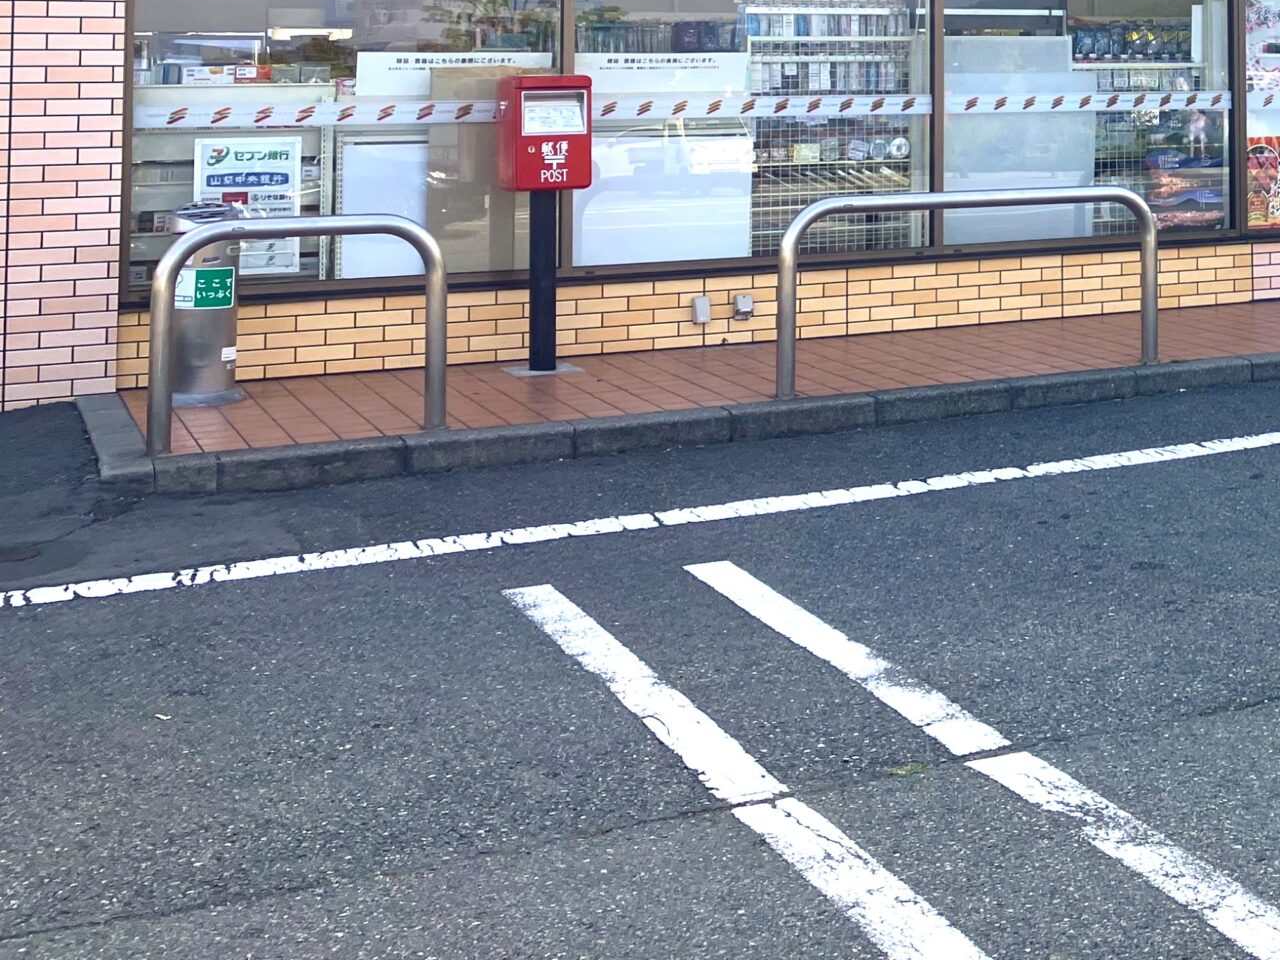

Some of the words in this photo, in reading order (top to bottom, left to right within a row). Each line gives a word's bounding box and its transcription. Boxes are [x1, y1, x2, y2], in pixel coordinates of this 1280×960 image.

[541, 141, 569, 156] 郵便
[234, 150, 290, 161] セブン銀行
[541, 169, 569, 183] POST
[196, 289, 232, 299] いっぷく
